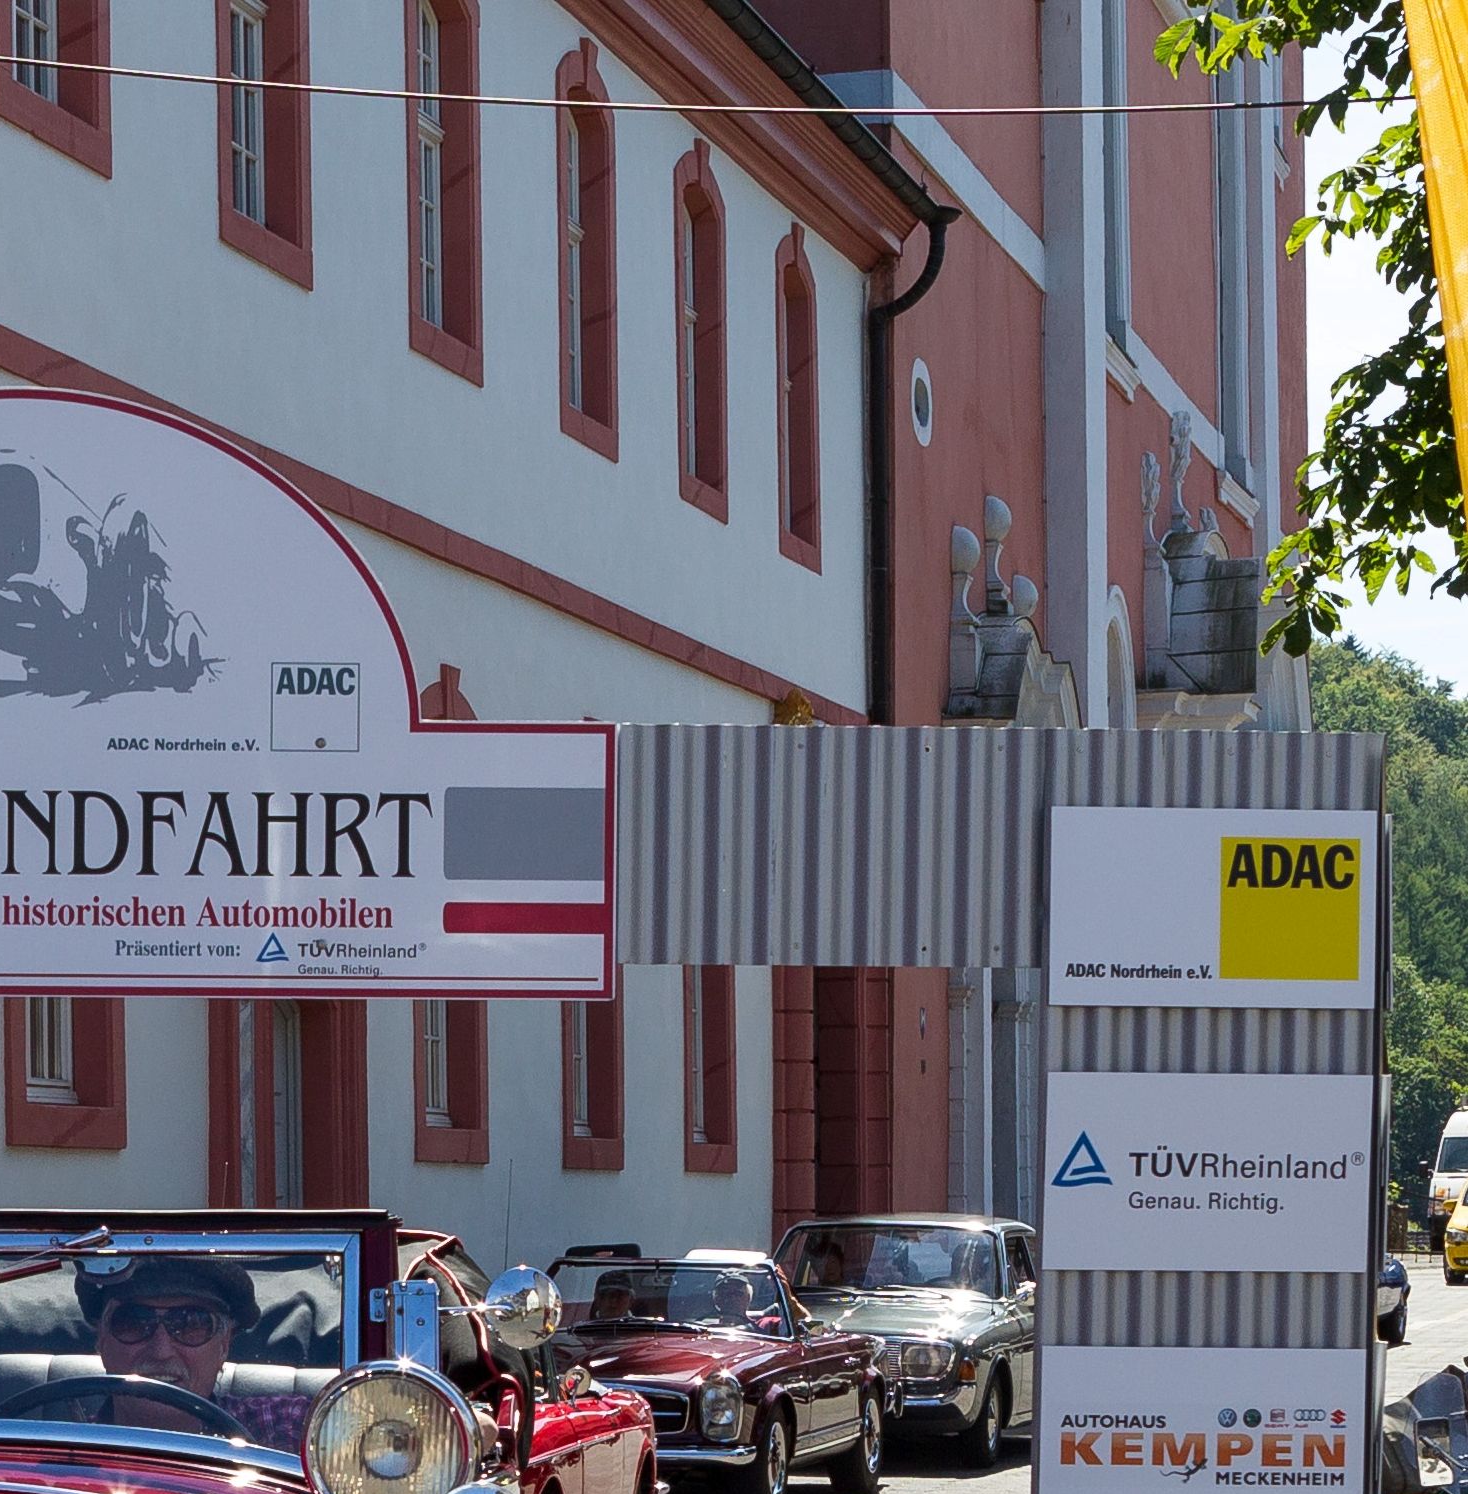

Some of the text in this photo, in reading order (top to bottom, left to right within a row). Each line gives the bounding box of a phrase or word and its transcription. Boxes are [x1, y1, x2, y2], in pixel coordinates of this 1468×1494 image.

[276, 667, 356, 696] ADAC
[107, 738, 260, 752] ADAC Nordrhein e.V.
[1227, 843, 1355, 889] ADAC
[2, 895, 186, 927] historischen
[195, 896, 393, 929] Automobilen
[115, 939, 241, 957] Präsentiert von:
[298, 964, 382, 977] Genau. Richtig.
[1065, 963, 1213, 979] ADAC Nordrhein e.V.
[1128, 1191, 1284, 1214] Genau. Richtig.
[1061, 1414, 1166, 1429] AUTOHAUS
[1060, 1432, 1346, 1467] KEMPEN
[1216, 1472, 1345, 1486] MECKENHEIM
